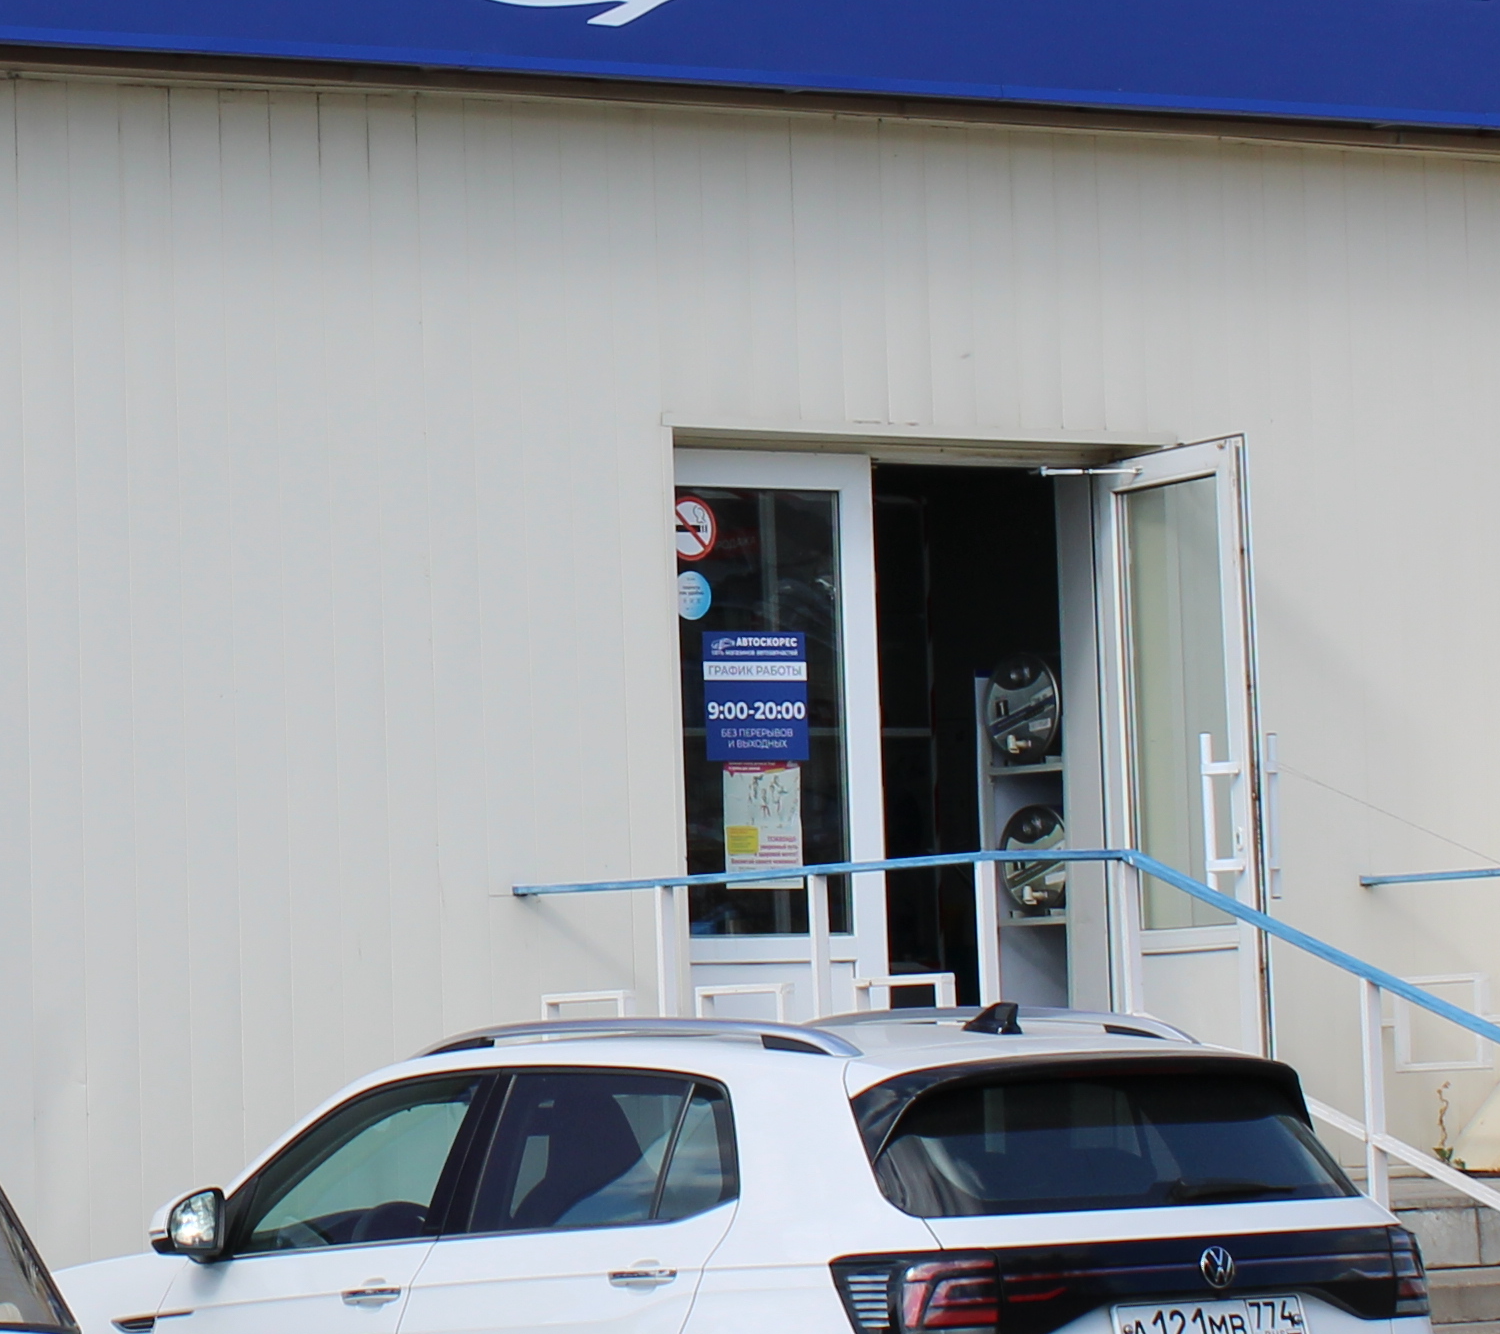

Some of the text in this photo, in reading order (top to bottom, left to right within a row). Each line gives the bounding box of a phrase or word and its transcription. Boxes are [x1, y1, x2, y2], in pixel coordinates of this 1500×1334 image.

[735, 636, 799, 648] АВТОСКОРЕС
[707, 664, 803, 677] ГРАФИК РАБОТЫ
[707, 701, 806, 720] 9:00-20:00
[721, 728, 794, 738] БЕЗ ПЕРЕРЫВОВ
[728, 739, 788, 749] И ВЫХОДНЫХ
[1248, 1300, 1294, 1330] 774
